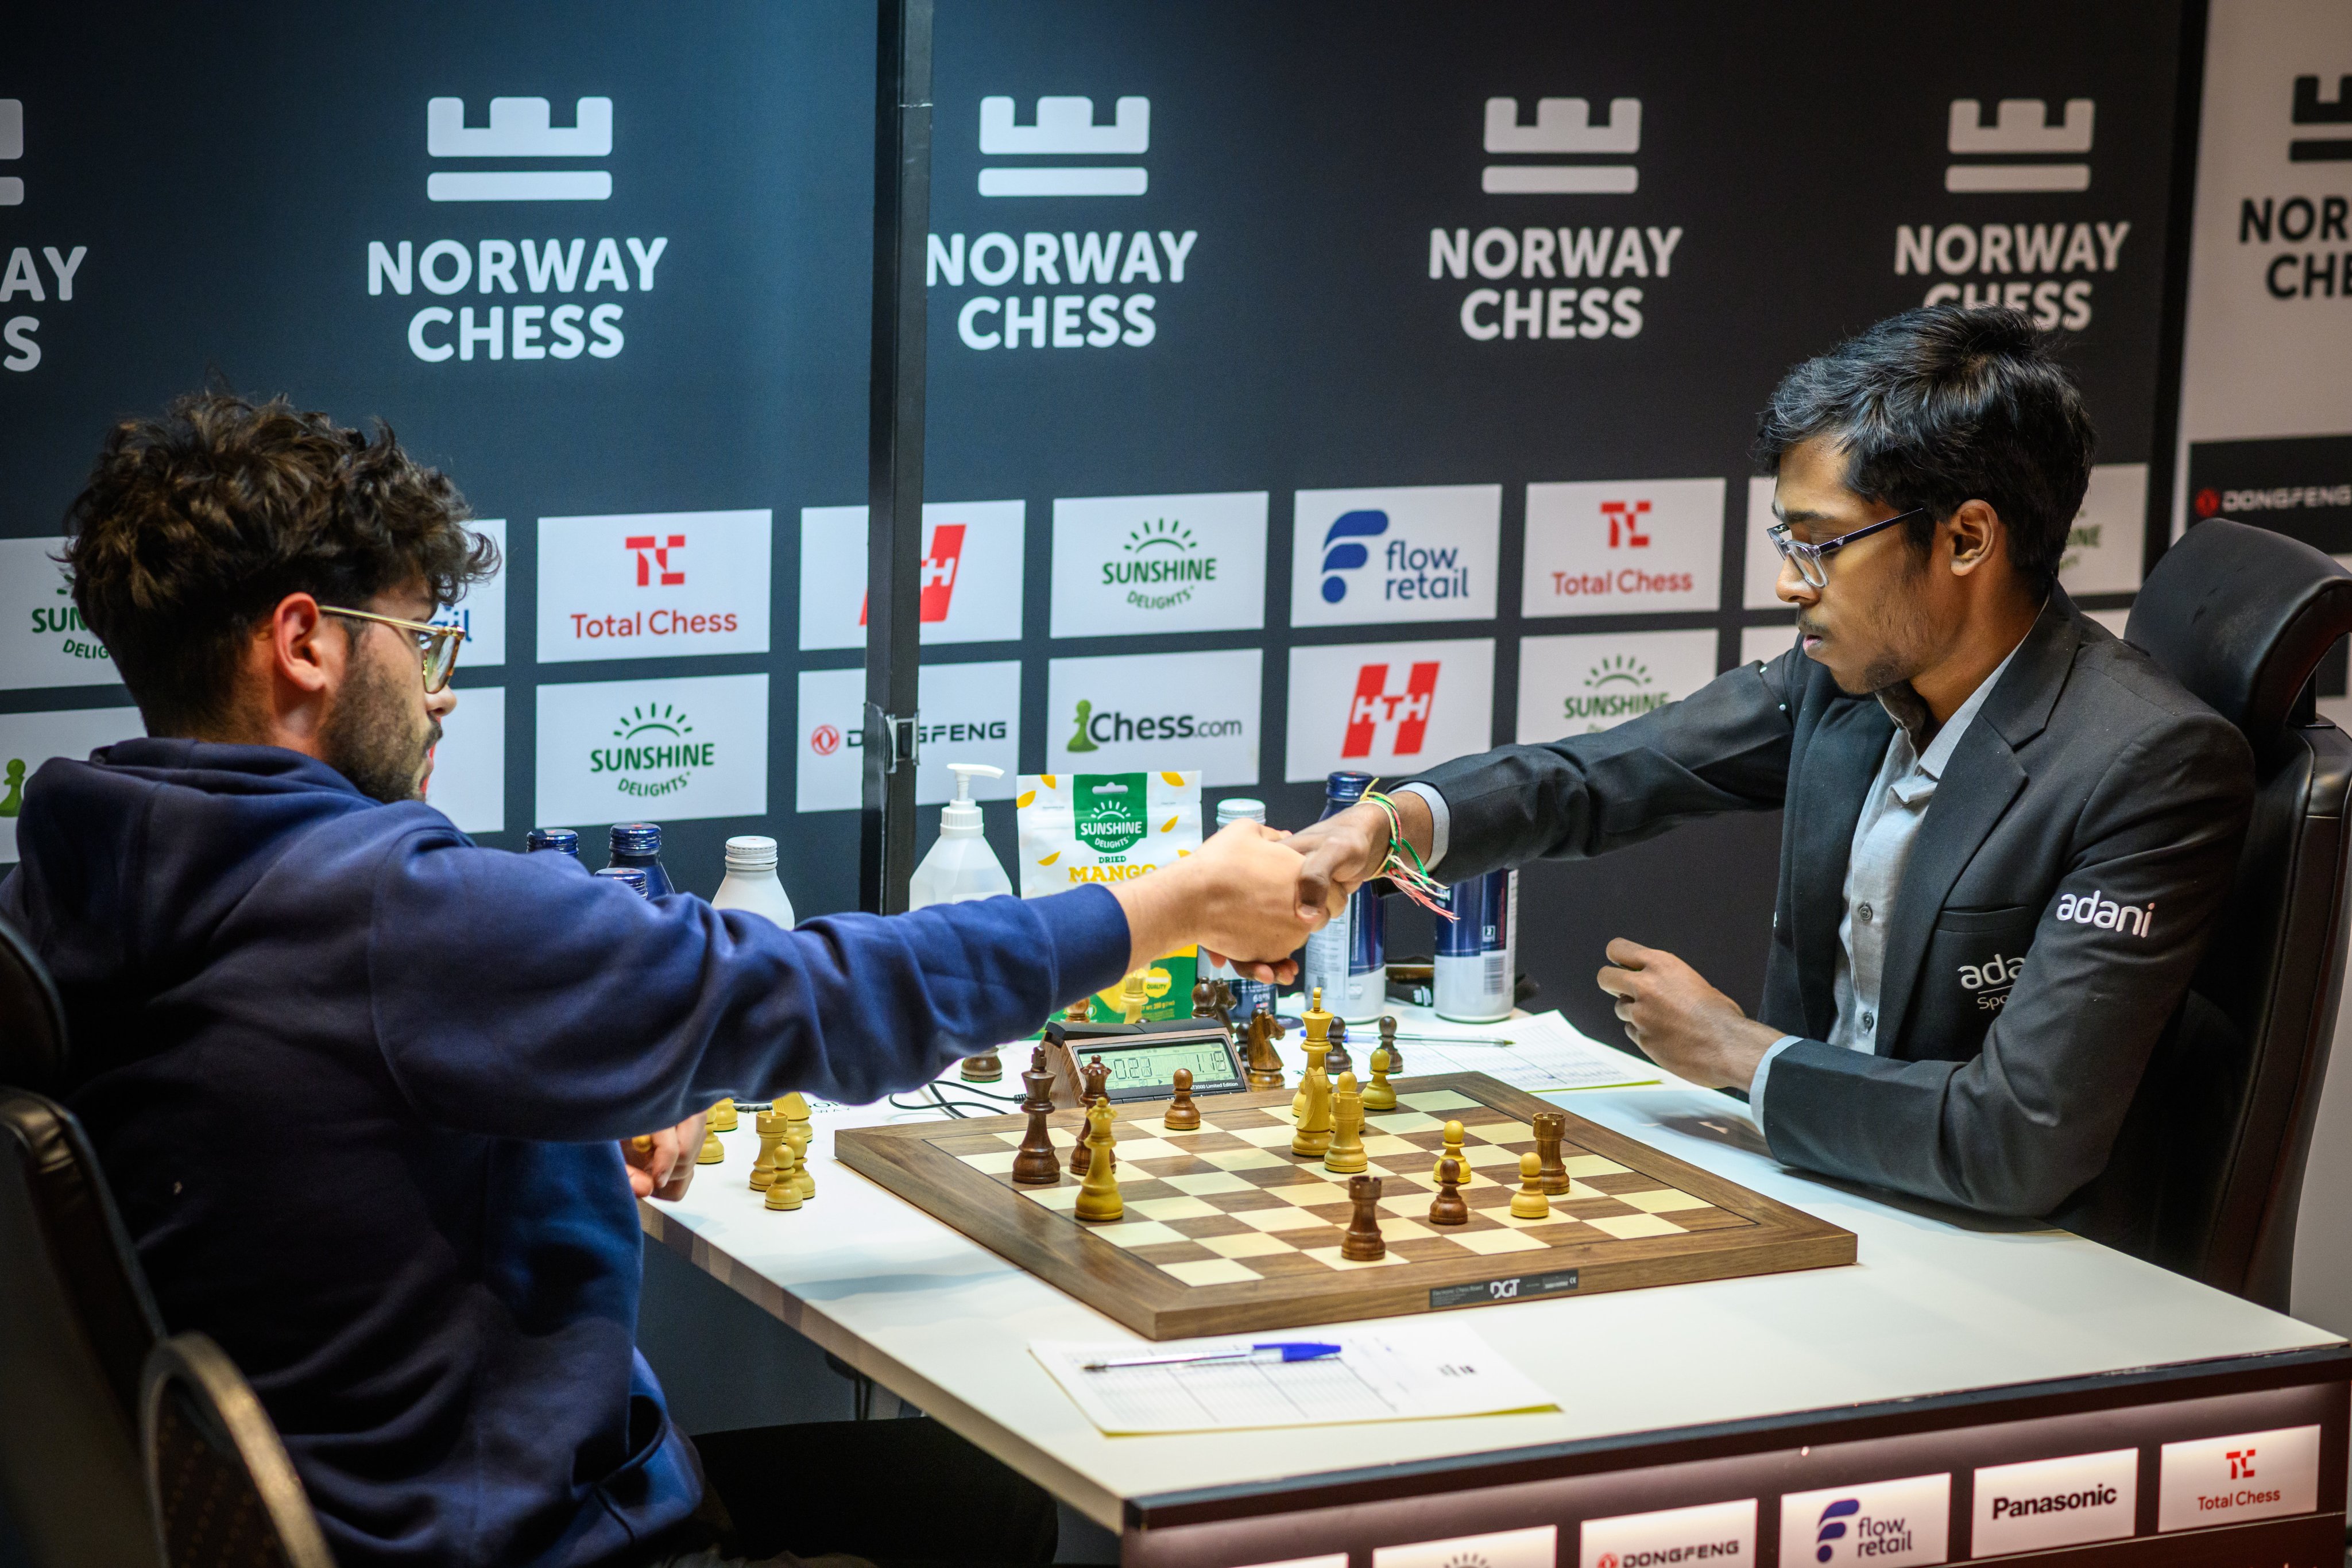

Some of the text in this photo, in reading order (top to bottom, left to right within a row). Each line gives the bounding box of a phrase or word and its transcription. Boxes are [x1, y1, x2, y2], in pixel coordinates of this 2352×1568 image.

[2239, 196, 2351, 244] NOR
[927, 231, 1198, 287] NORWAY
[1429, 226, 1684, 280] NORWAY
[1894, 222, 2132, 276] NORWAY
[368, 237, 668, 295] NORWAY
[958, 293, 1156, 350] CHESS
[1460, 287, 1644, 340] CHESS
[408, 303, 624, 362] CHESS
[1384, 540, 1459, 571] flow
[1102, 558, 1217, 584] SUNSHINE
[1386, 567, 1469, 600] retail
[1552, 569, 1693, 595] Total Chess
[1127, 588, 1192, 610] DELIGHTS
[570, 610, 737, 639] Total Chess
[63, 639, 109, 659] DELIG
[1090, 712, 1242, 743] Chess.com
[590, 743, 714, 772] SUNSHINE
[617, 773, 688, 797] DELIGHTS
[1080, 822, 1143, 835] SUNSHINE
[1094, 837, 1128, 848] DELIGHTS
[1098, 855, 1126, 864] DRIED
[2056, 890, 2155, 938] adani
[1958, 954, 2025, 990] ada
[1977, 996, 2009, 1011] Spo
[1490, 1279, 1521, 1299] DGT
[1991, 1483, 2118, 1520] Panasonic
[2198, 1488, 2281, 1511] Total Chess
[1858, 1516, 1905, 1538] flow
[1622, 1540, 1739, 1568] DONGFENG
[1857, 1530, 1912, 1558] retail
